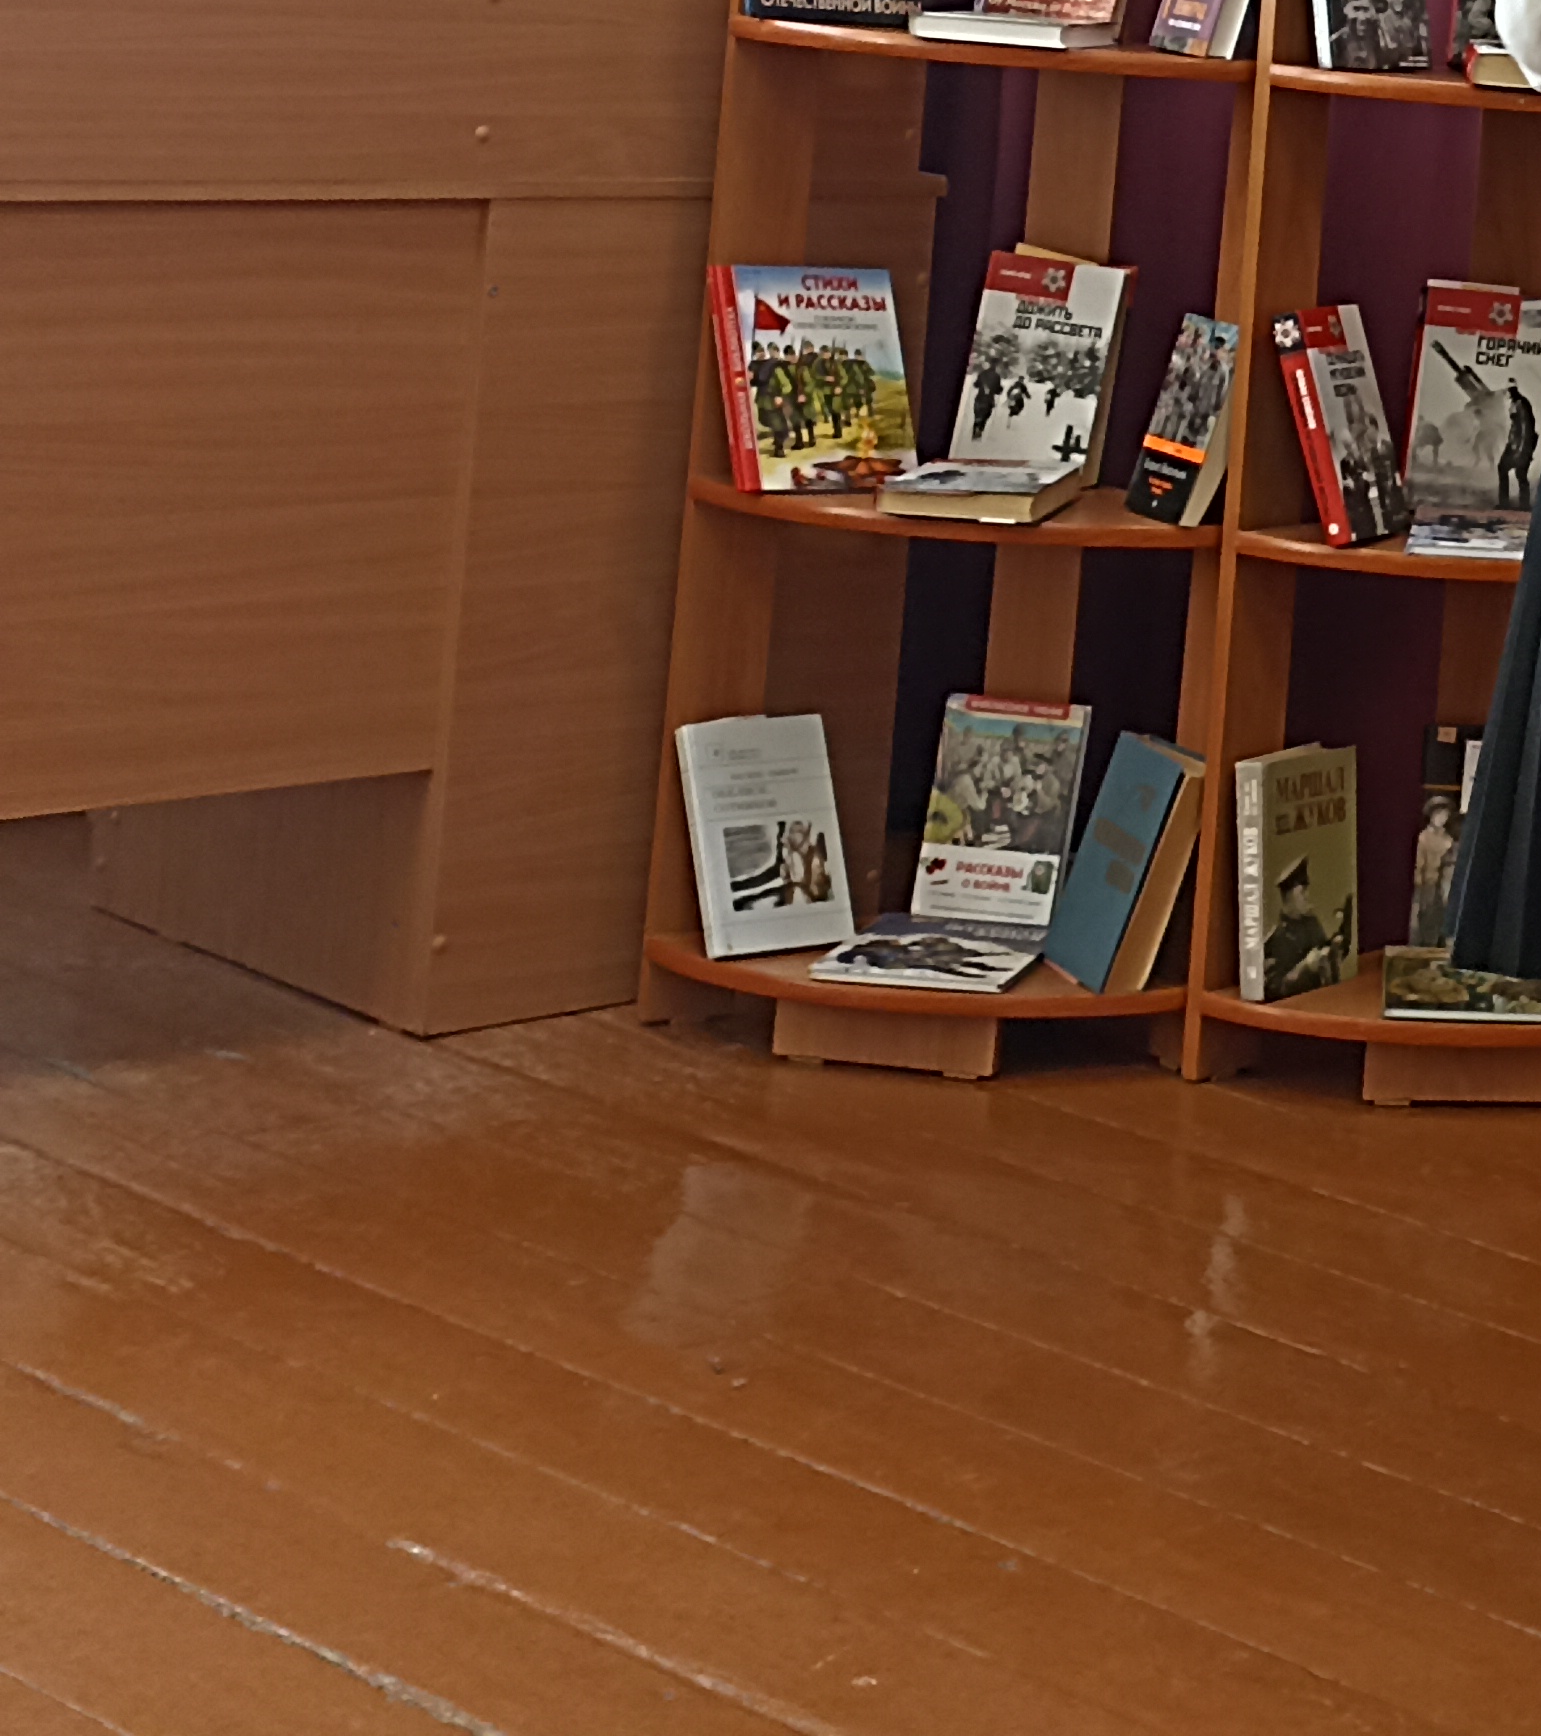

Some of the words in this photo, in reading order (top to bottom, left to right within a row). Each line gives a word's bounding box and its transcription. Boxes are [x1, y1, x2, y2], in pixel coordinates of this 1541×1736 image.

[801, 274, 859, 292] СТИХИ
[777, 292, 791, 310] И
[795, 293, 888, 313] РАССКАЗЫ
[1475, 351, 1514, 368] СНЕГ
